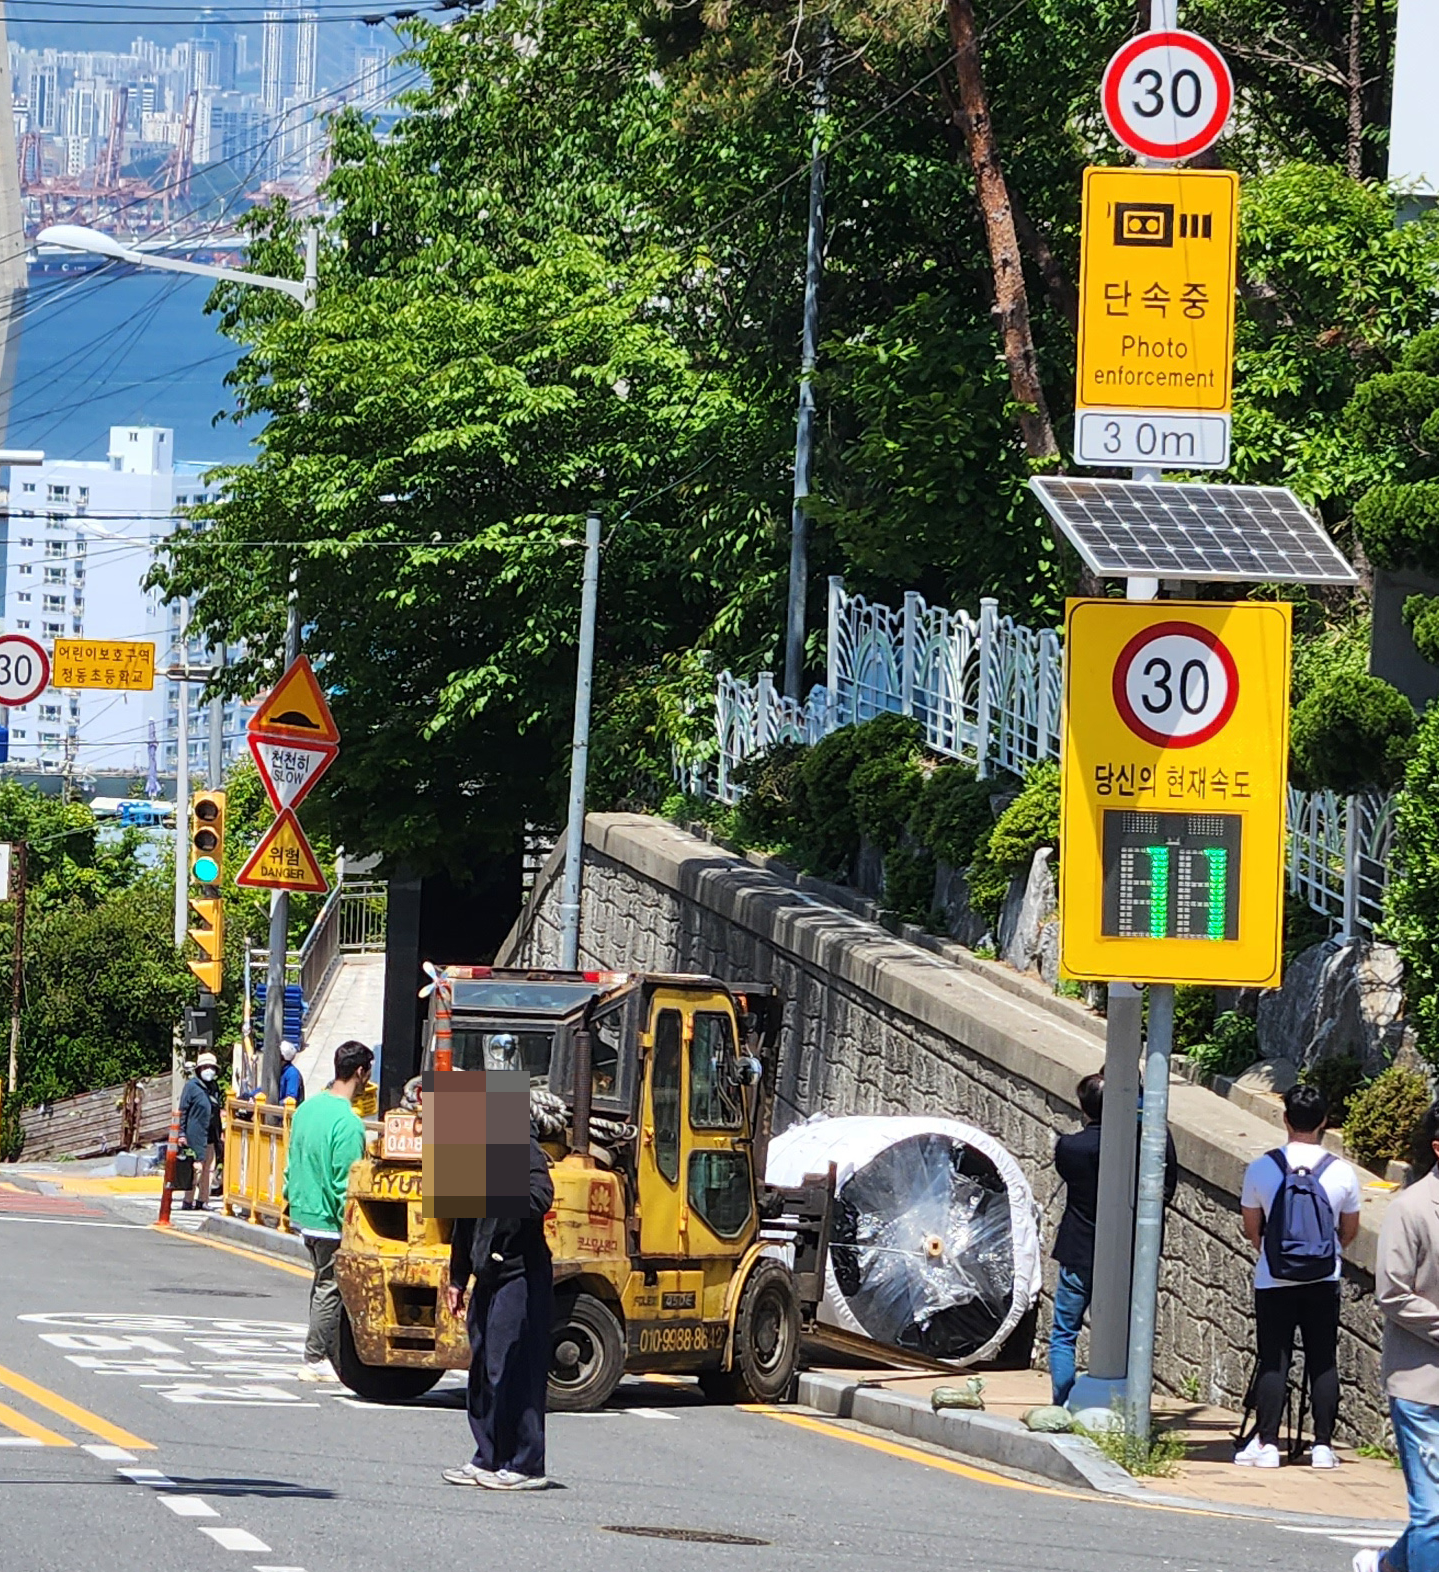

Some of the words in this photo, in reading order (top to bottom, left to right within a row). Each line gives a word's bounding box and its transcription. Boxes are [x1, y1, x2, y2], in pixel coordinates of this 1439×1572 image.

[1132, 68, 1203, 118] 30
[1121, 335, 1188, 359] Photo
[1094, 365, 1215, 389] enforcement
[58, 646, 150, 665] 어린이보호구역
[1141, 657, 1210, 715] 30
[271, 750, 310, 774] 천천히
[273, 770, 304, 785] SLOW
[1094, 763, 1156, 798] 당신의
[1166, 764, 1252, 800] 현재속도
[268, 846, 300, 867] 위험
[260, 866, 305, 880] DANGER
